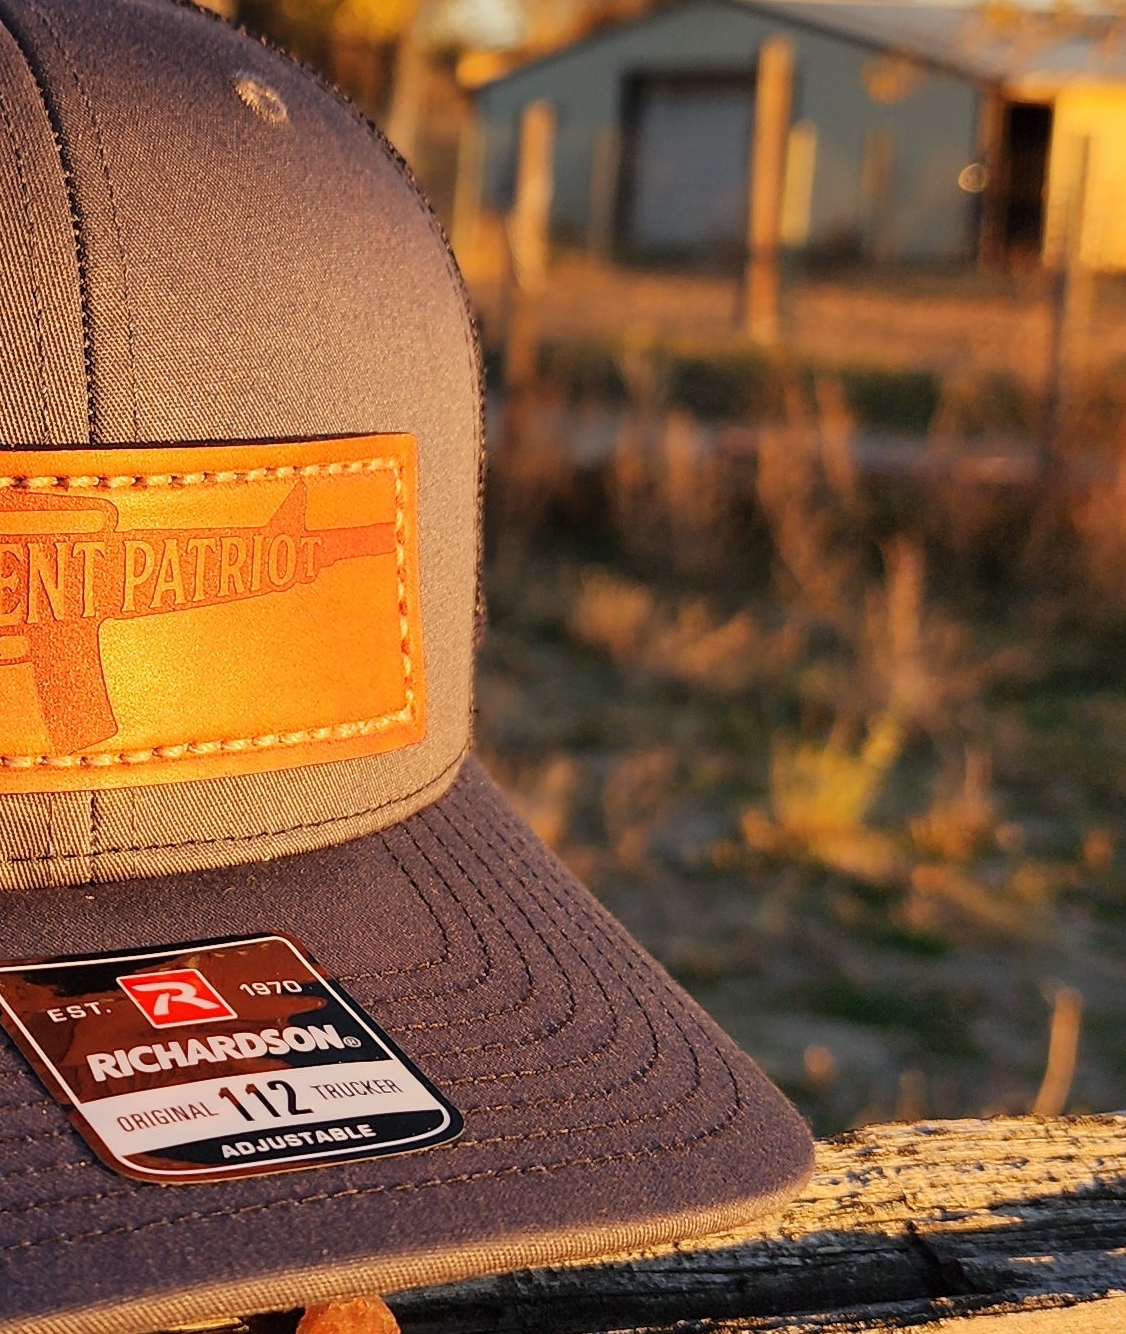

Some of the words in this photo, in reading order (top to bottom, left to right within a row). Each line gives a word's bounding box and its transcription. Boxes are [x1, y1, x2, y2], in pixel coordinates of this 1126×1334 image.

[123, 533, 324, 610] PATRIOT
[46, 1001, 112, 1023] EST.
[239, 979, 302, 997] 1970
[116, 1101, 218, 1133] ORIGINAL
[217, 1079, 314, 1122] 112
[313, 1078, 403, 1101] TRUCKER
[221, 1123, 377, 1159] ADJUSTABLE
